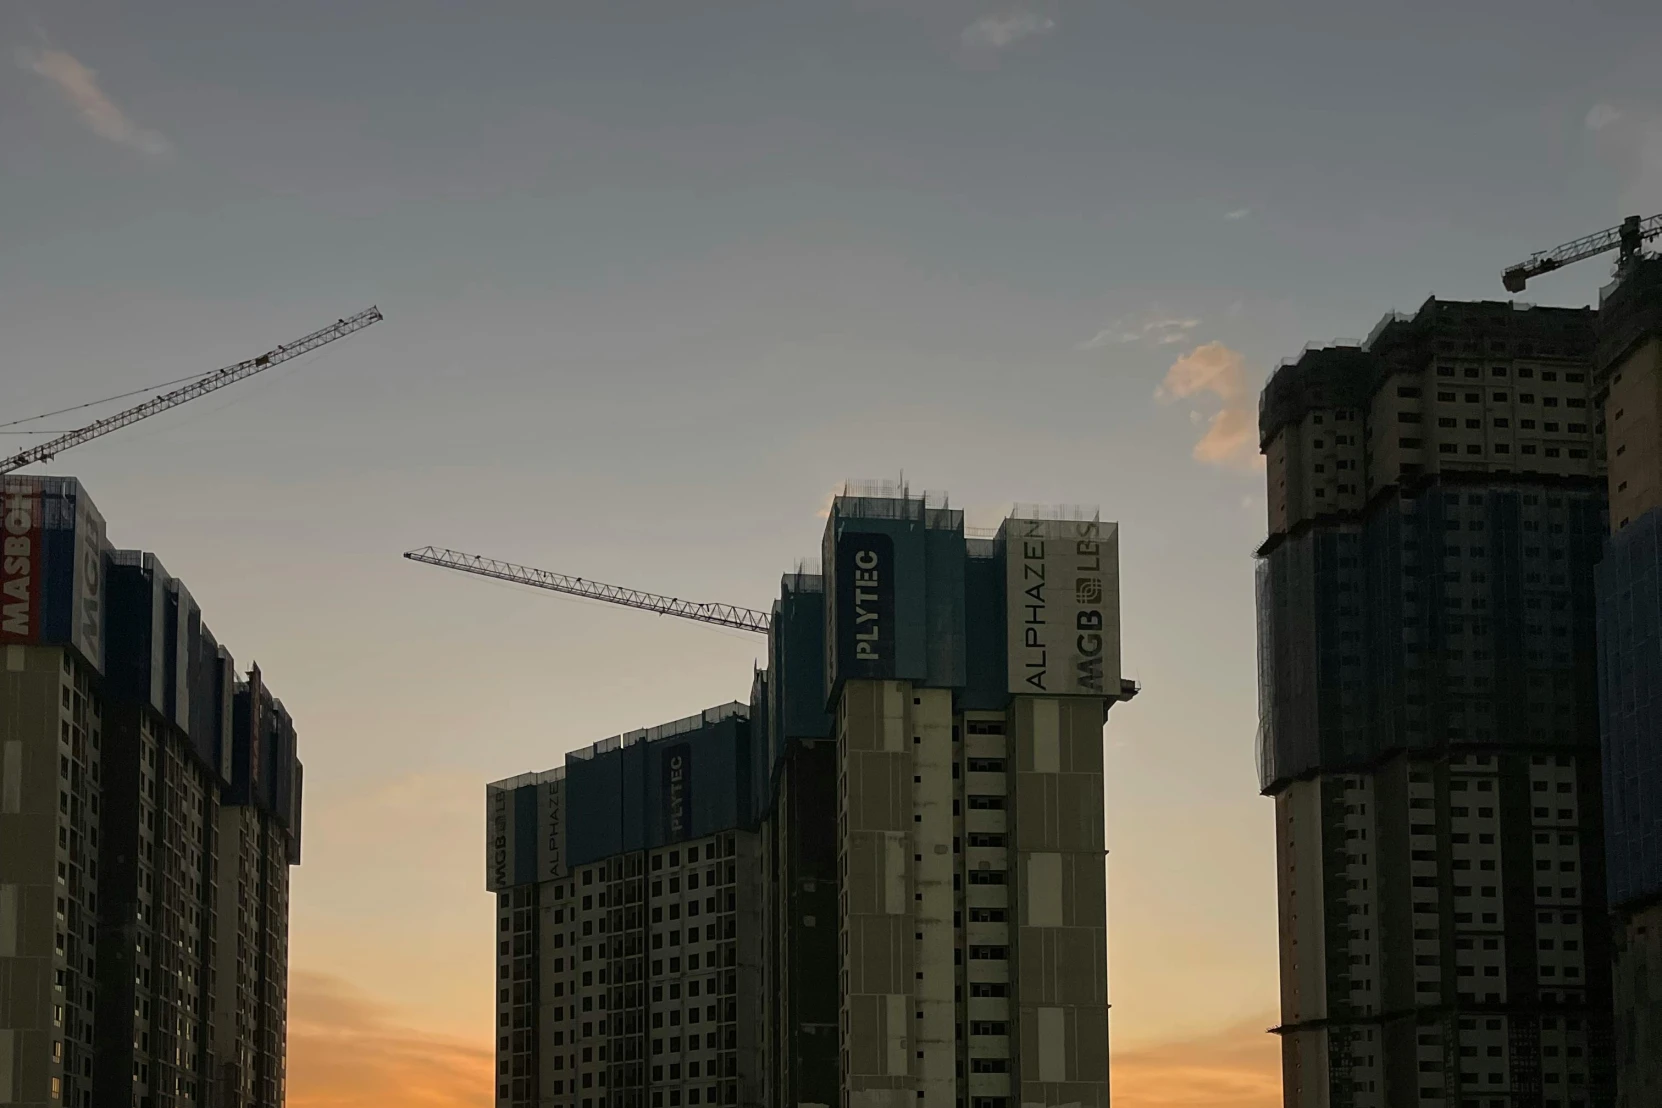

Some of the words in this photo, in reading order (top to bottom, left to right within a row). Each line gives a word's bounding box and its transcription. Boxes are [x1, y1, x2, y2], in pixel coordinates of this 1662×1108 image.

[1077, 522, 1100, 571] LBS
[855, 549, 879, 660] PLYTEC
[1023, 520, 1047, 691] ALPHAZEN
[1077, 610, 1103, 693] MGB
[670, 755, 682, 831] PLYTEC
[495, 835, 507, 886] MGB
